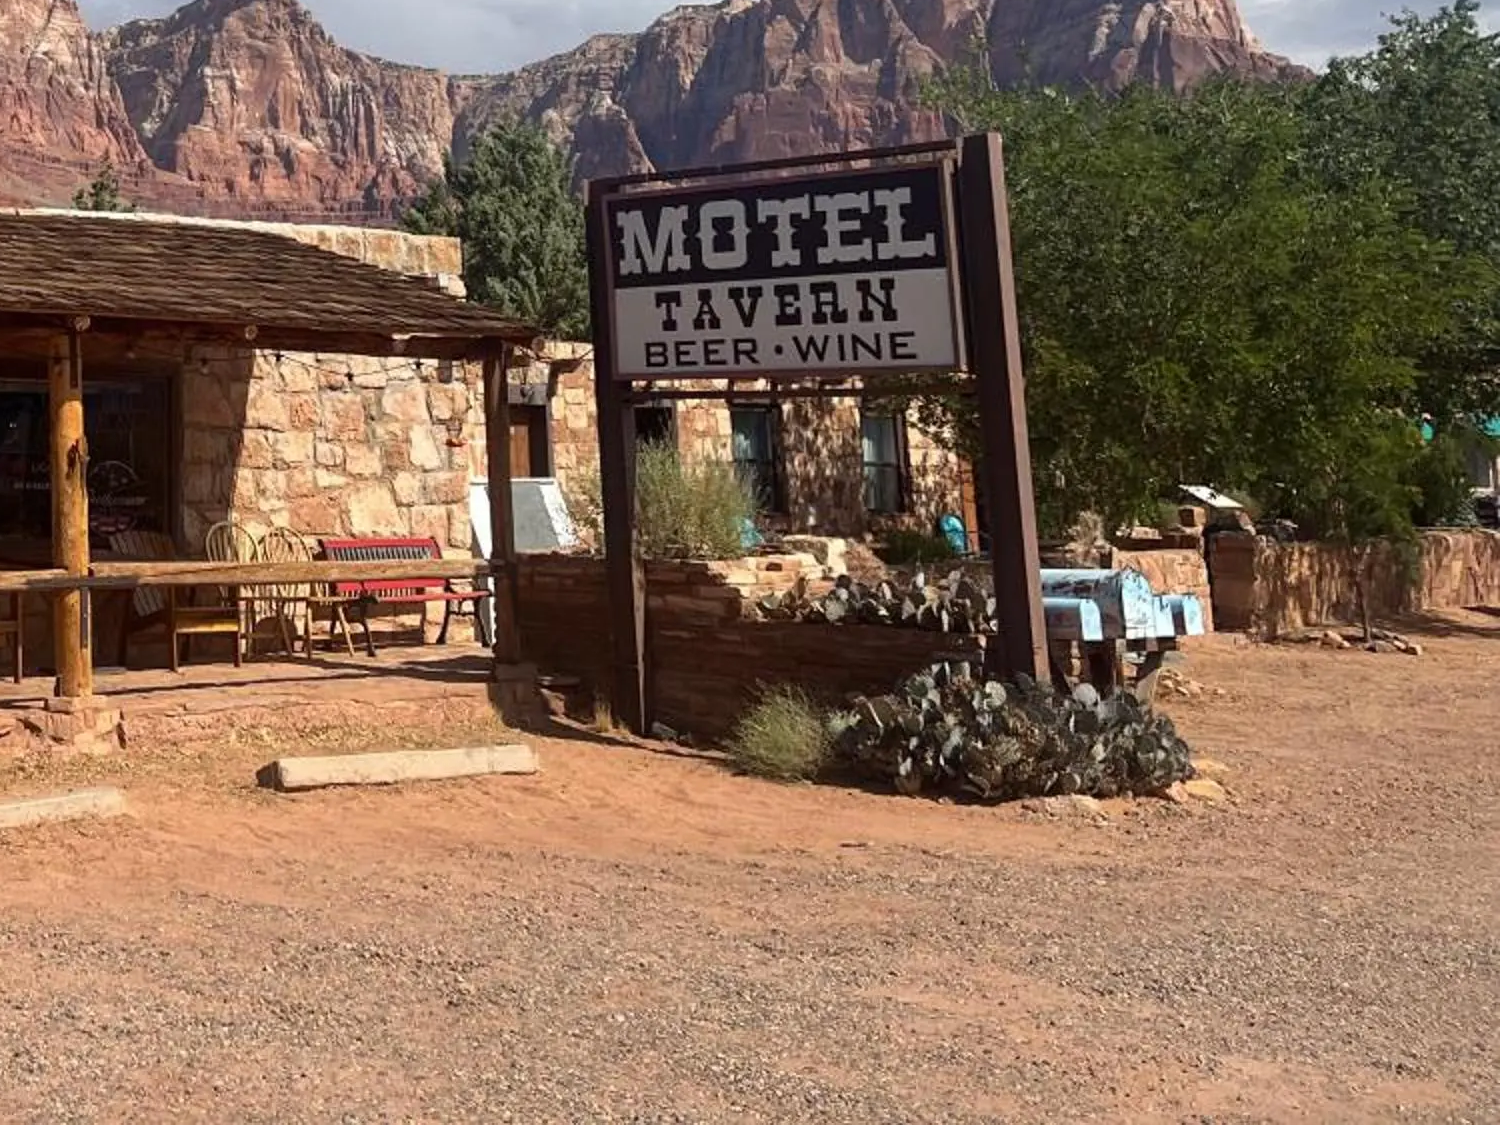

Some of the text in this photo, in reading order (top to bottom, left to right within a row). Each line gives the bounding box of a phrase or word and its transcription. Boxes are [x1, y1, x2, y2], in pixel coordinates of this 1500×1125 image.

[616, 186, 937, 275] MOTEL
[654, 277, 899, 332] TAVERN
[645, 330, 919, 368] BEER WINE
